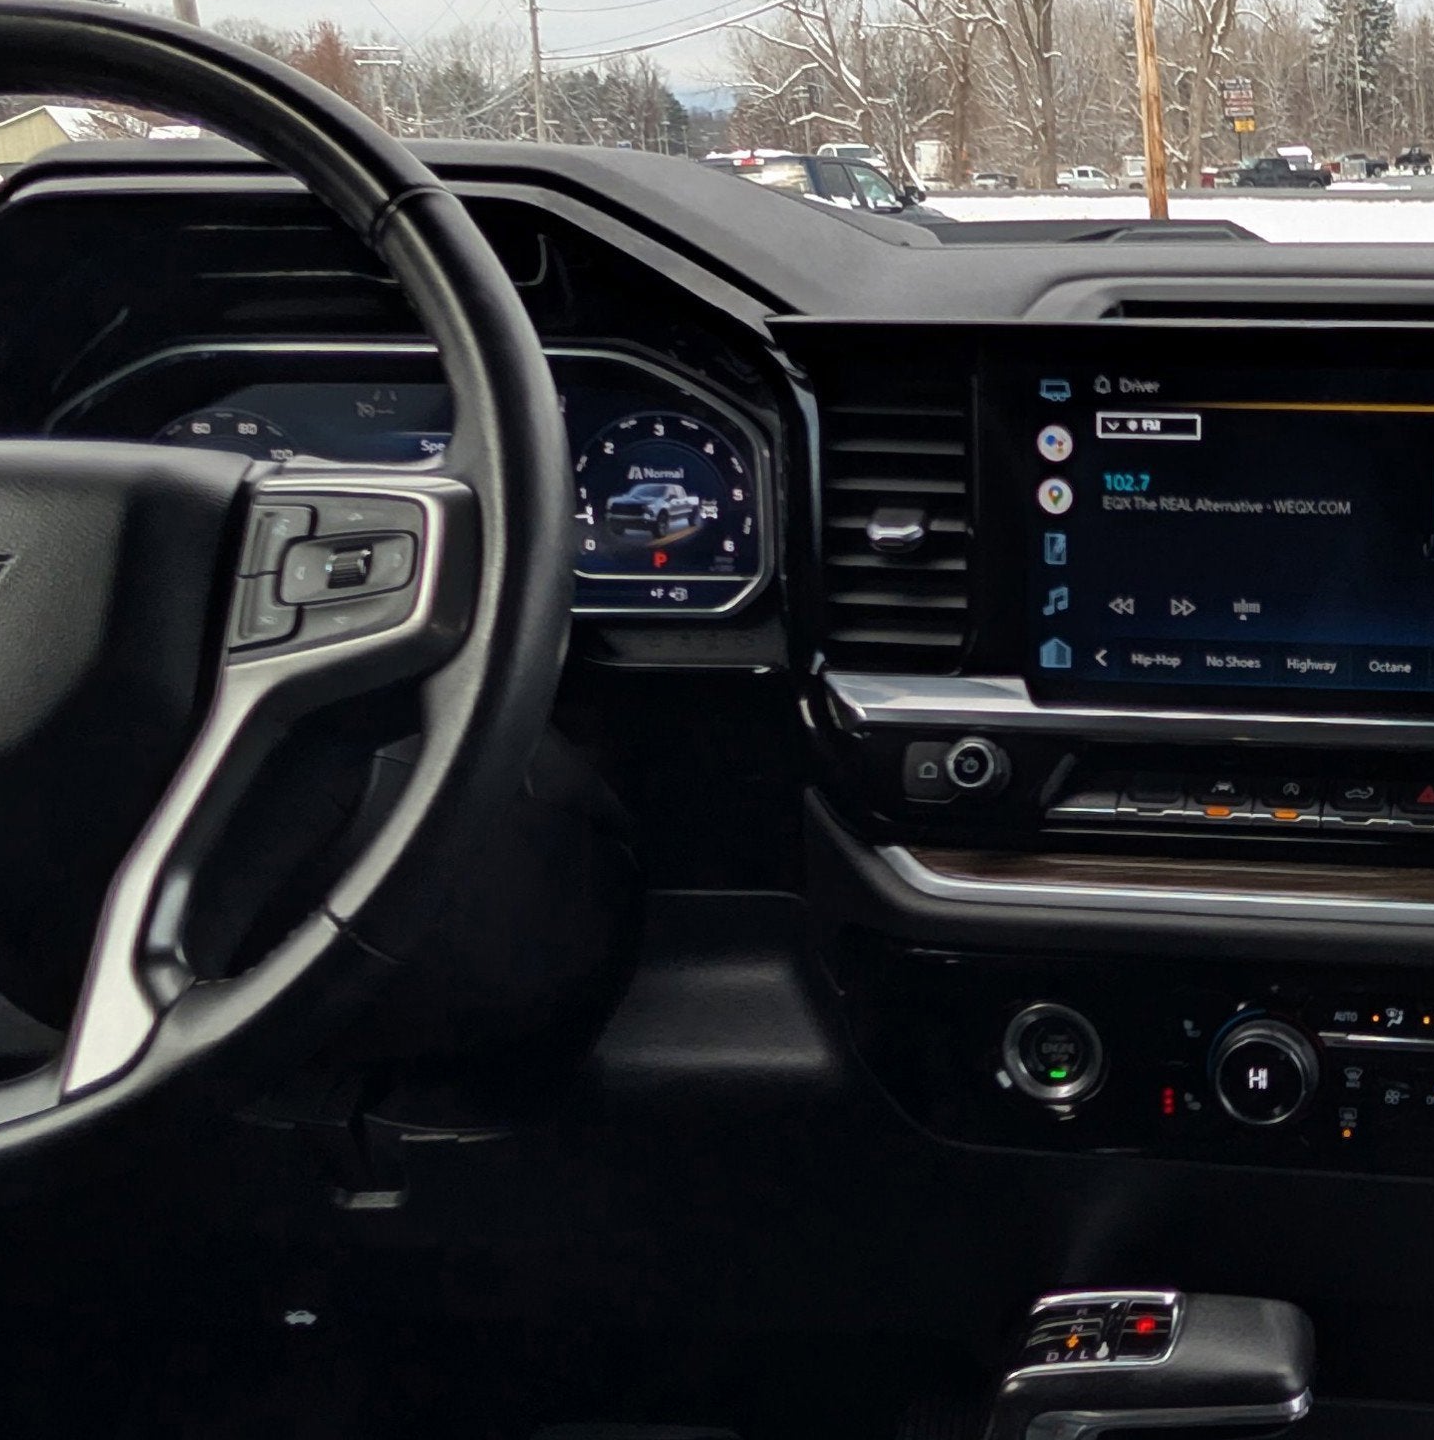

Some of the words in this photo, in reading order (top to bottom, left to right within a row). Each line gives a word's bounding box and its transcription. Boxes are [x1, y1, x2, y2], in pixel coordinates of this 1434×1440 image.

[1119, 378, 1161, 393] Driver
[653, 423, 664, 436] 3
[604, 442, 614, 455] 2
[643, 467, 685, 480] Normal
[1103, 474, 1150, 491] 102.7
[1133, 496, 1158, 510] The
[1160, 497, 1195, 512] REAL
[1197, 499, 1264, 514] Alternative
[1273, 500, 1352, 515] WEQX.COM
[652, 552, 668, 568] P
[1131, 652, 1182, 668] Hip-Hop
[1206, 655, 1223, 667] No
[1225, 656, 1261, 669] Shoes
[1286, 658, 1337, 674] Highway
[1369, 661, 1412, 674] Octane
[1333, 1010, 1359, 1022] AUTO
[1248, 1067, 1268, 1090] HI
